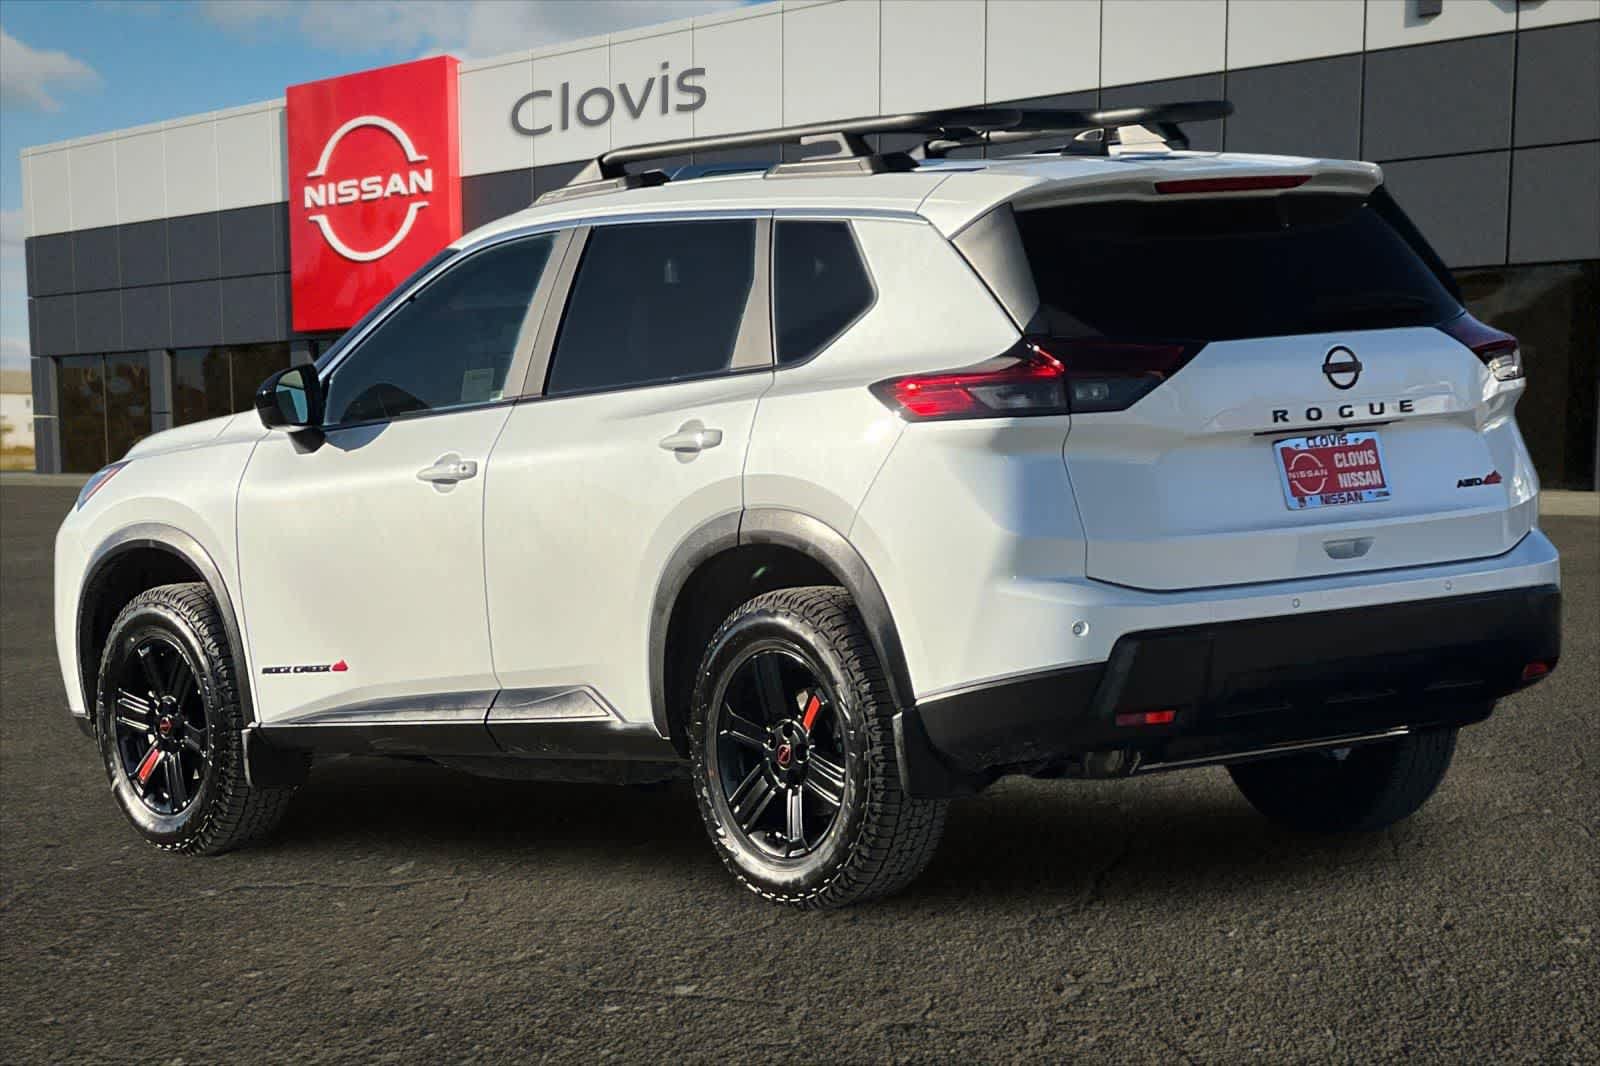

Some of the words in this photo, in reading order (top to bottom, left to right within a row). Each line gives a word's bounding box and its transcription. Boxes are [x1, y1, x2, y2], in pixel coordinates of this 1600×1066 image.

[511, 62, 708, 137] Clovis
[303, 168, 433, 208] NISSAN
[1272, 399, 1415, 423] ROGUE
[1305, 432, 1348, 449] CLOVIS
[1333, 449, 1377, 468] CLOVIS
[1288, 468, 1329, 480] NISSAN
[1338, 469, 1382, 489] NISSAN
[1320, 491, 1363, 505] NISSAN
